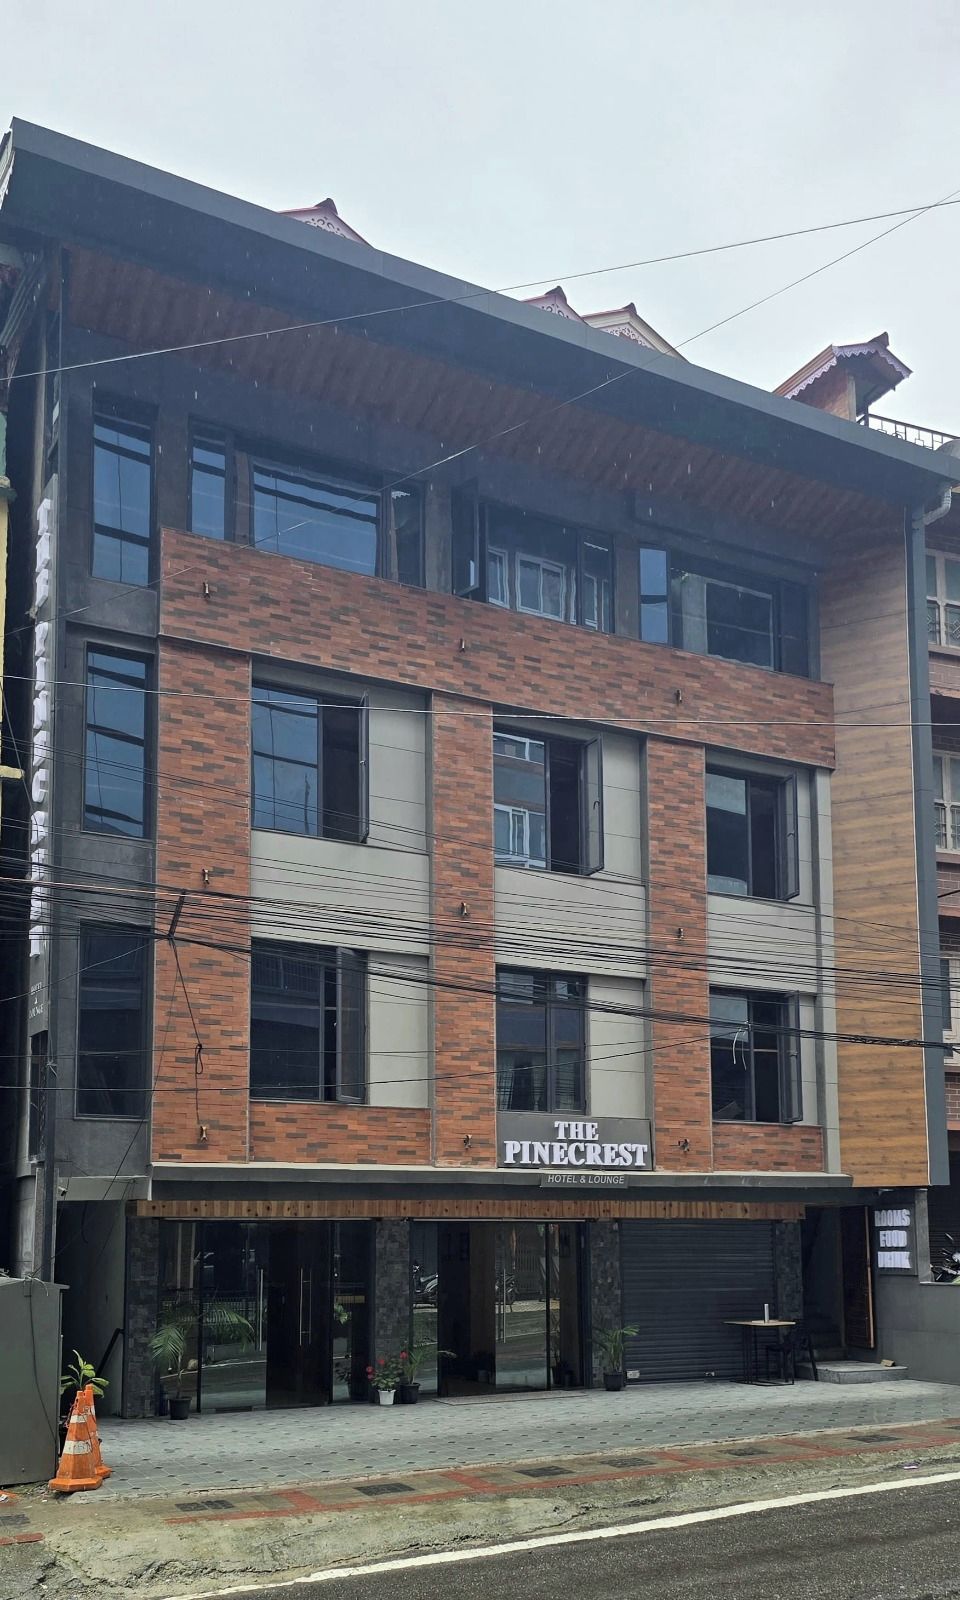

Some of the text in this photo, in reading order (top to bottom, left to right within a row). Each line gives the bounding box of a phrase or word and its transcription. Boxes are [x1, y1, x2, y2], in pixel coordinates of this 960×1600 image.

[555, 1121, 599, 1141] THE
[504, 1140, 648, 1167] PINECREST
[547, 1174, 625, 1184] HOTEL & LOUNGE
[874, 1209, 911, 1227] ROOMS
